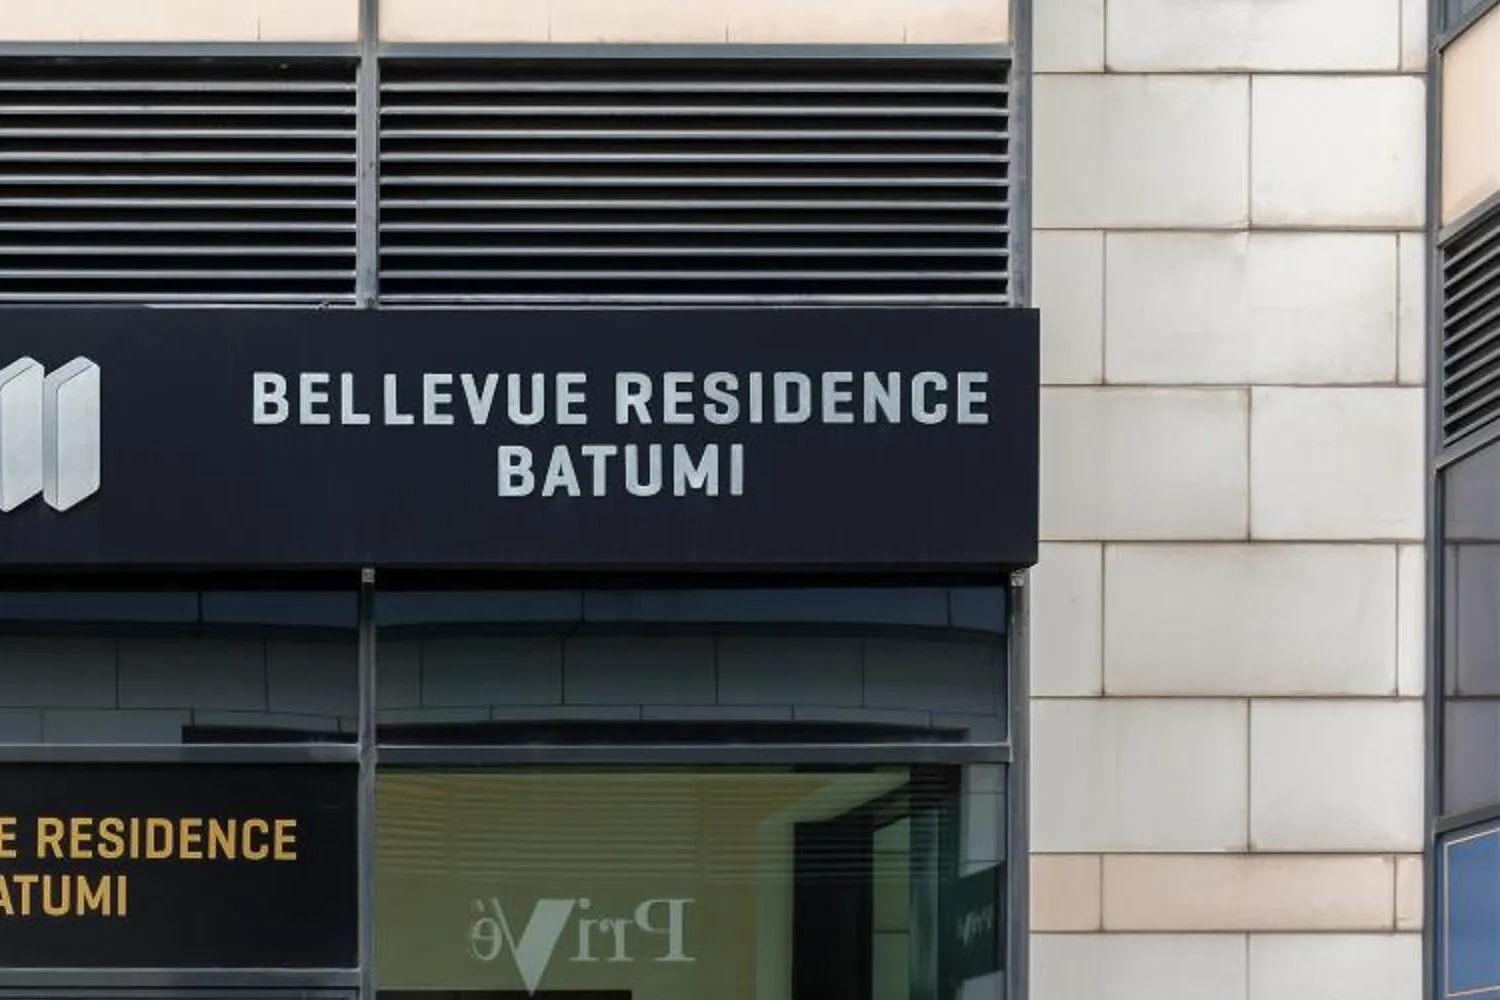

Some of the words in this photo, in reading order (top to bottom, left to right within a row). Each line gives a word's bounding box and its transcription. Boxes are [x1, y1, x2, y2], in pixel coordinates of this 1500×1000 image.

[251, 371, 589, 426] BELLEVUE
[614, 370, 990, 425] RESIDENCE
[496, 444, 745, 498] BATUMI
[35, 816, 298, 861] RESIDENCE
